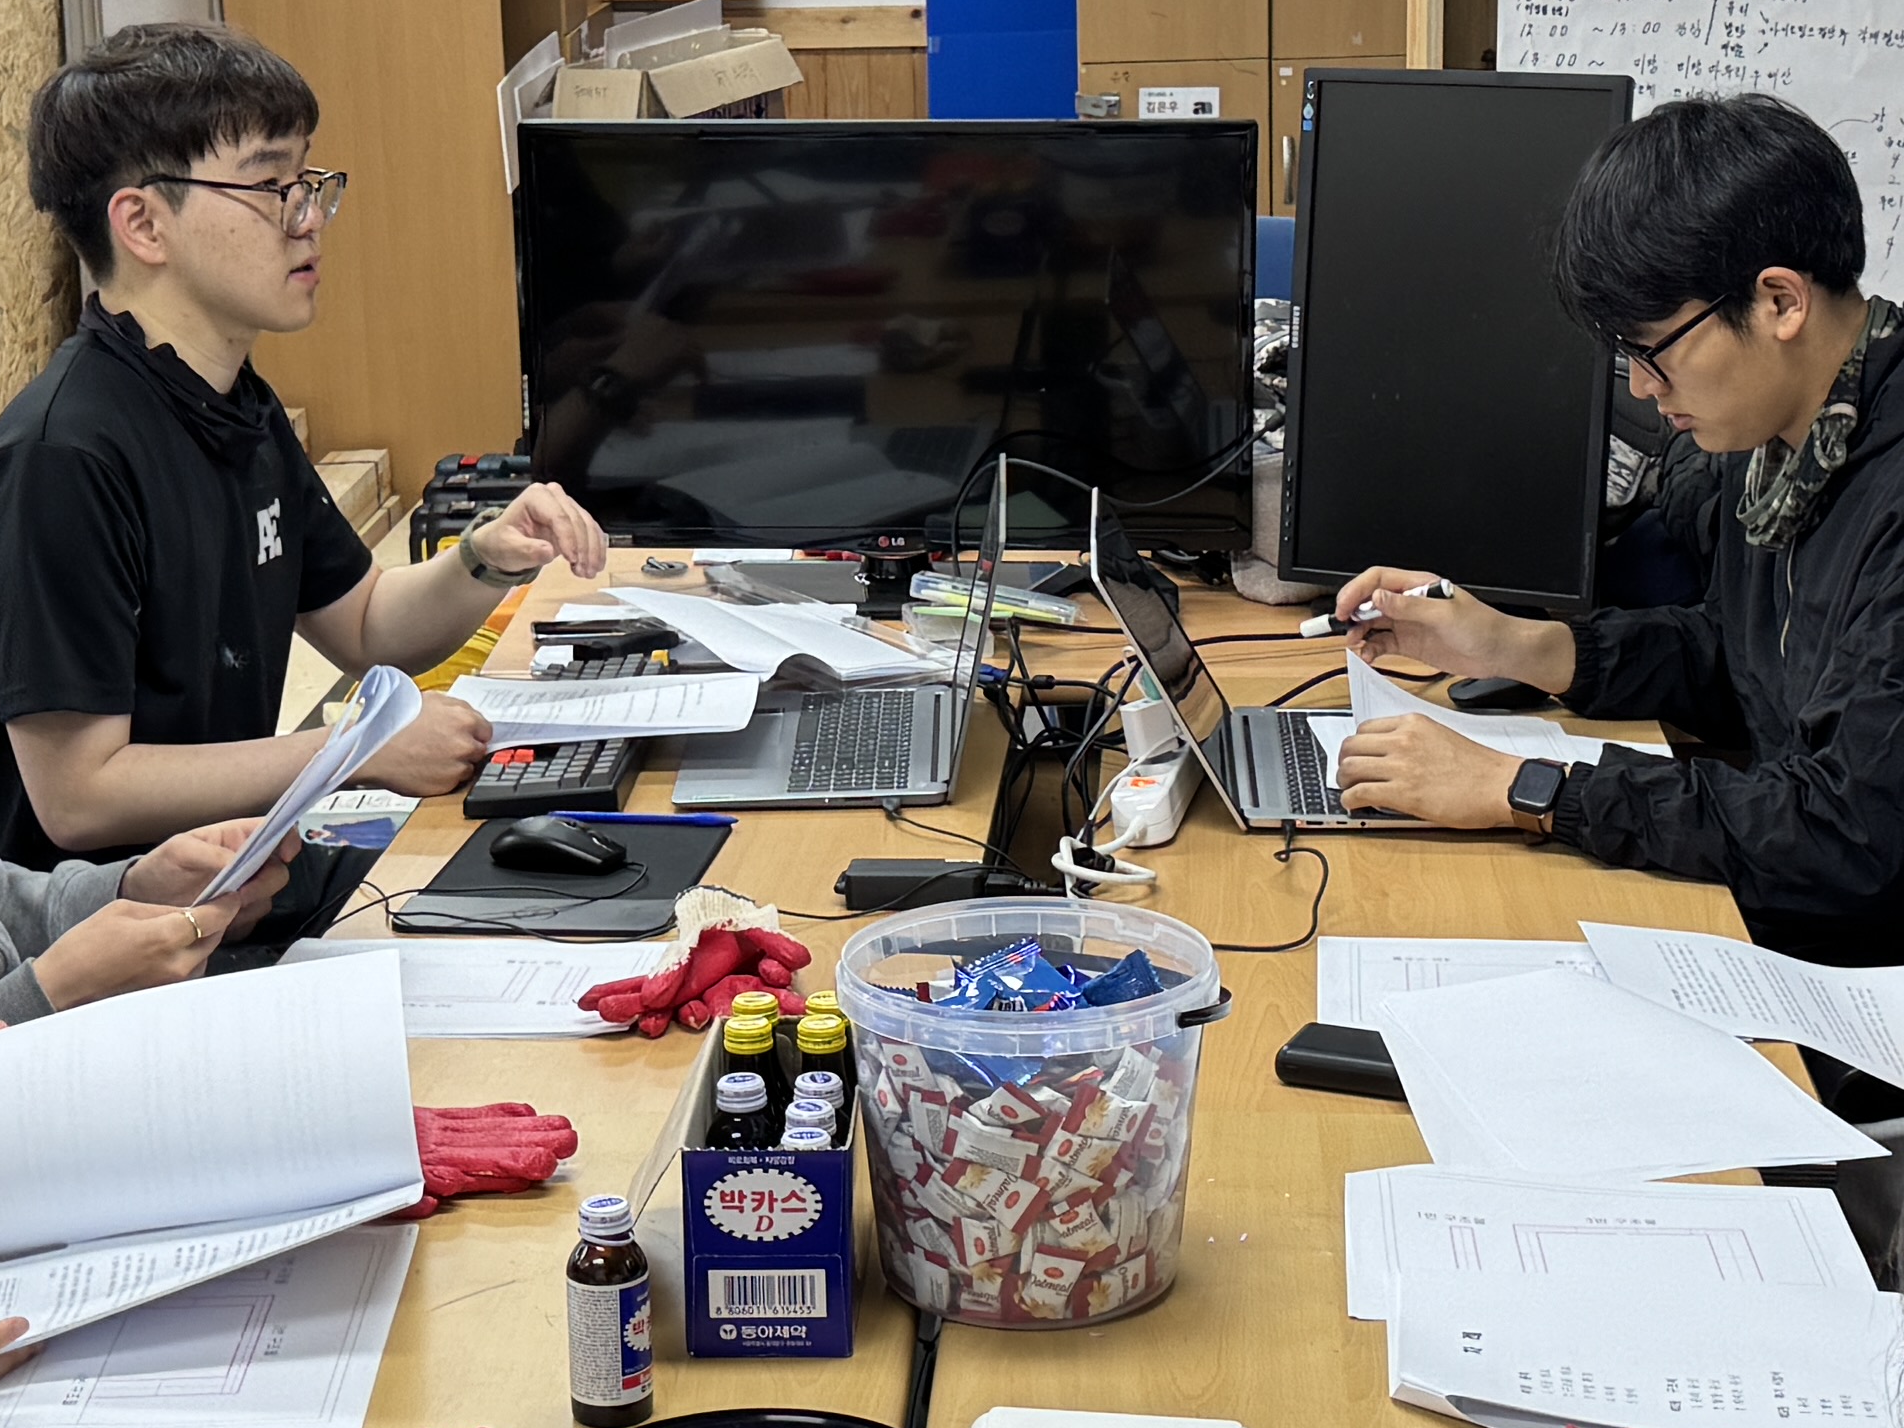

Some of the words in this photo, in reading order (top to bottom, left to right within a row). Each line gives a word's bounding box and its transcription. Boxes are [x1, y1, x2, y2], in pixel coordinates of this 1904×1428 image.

[891, 537, 905, 547] LG
[720, 1189, 808, 1214] 박카스
[755, 1215, 774, 1232] D
[741, 1325, 807, 1339] 동아제약
